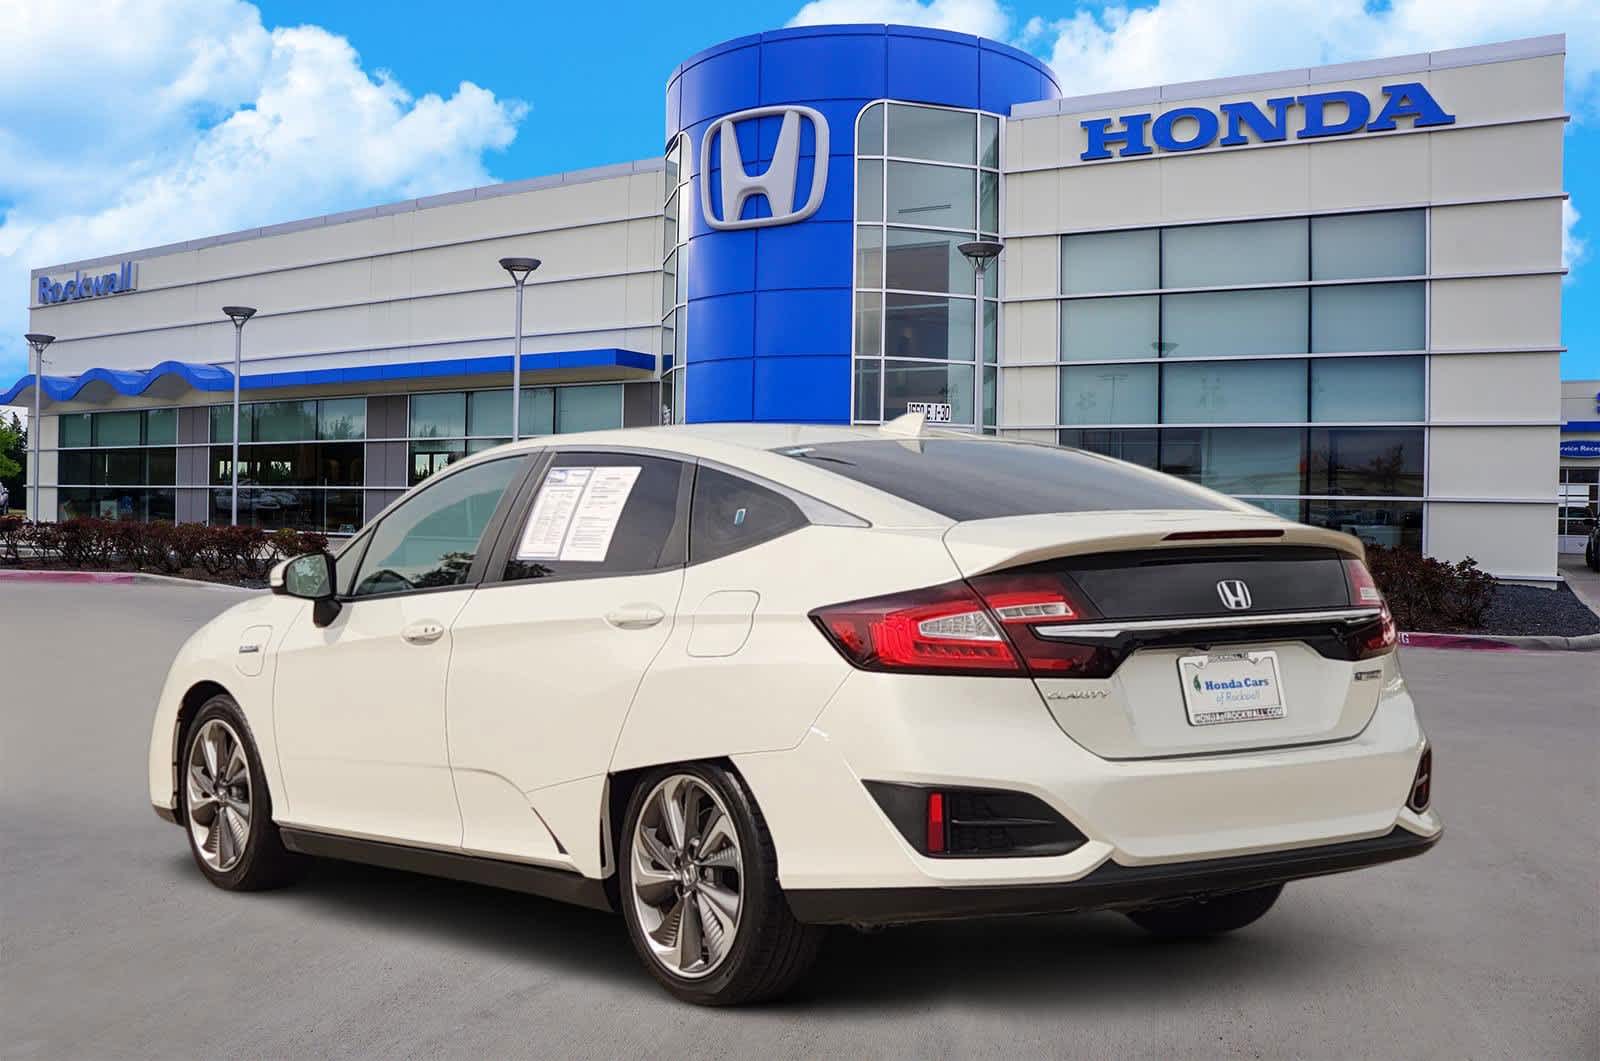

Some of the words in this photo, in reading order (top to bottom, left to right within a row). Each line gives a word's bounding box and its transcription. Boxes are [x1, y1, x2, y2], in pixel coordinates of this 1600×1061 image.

[1080, 83, 1456, 161] HONDA
[38, 260, 132, 304] Rockwall
[1204, 680, 1243, 691] Honda
[1244, 678, 1270, 688] Cars
